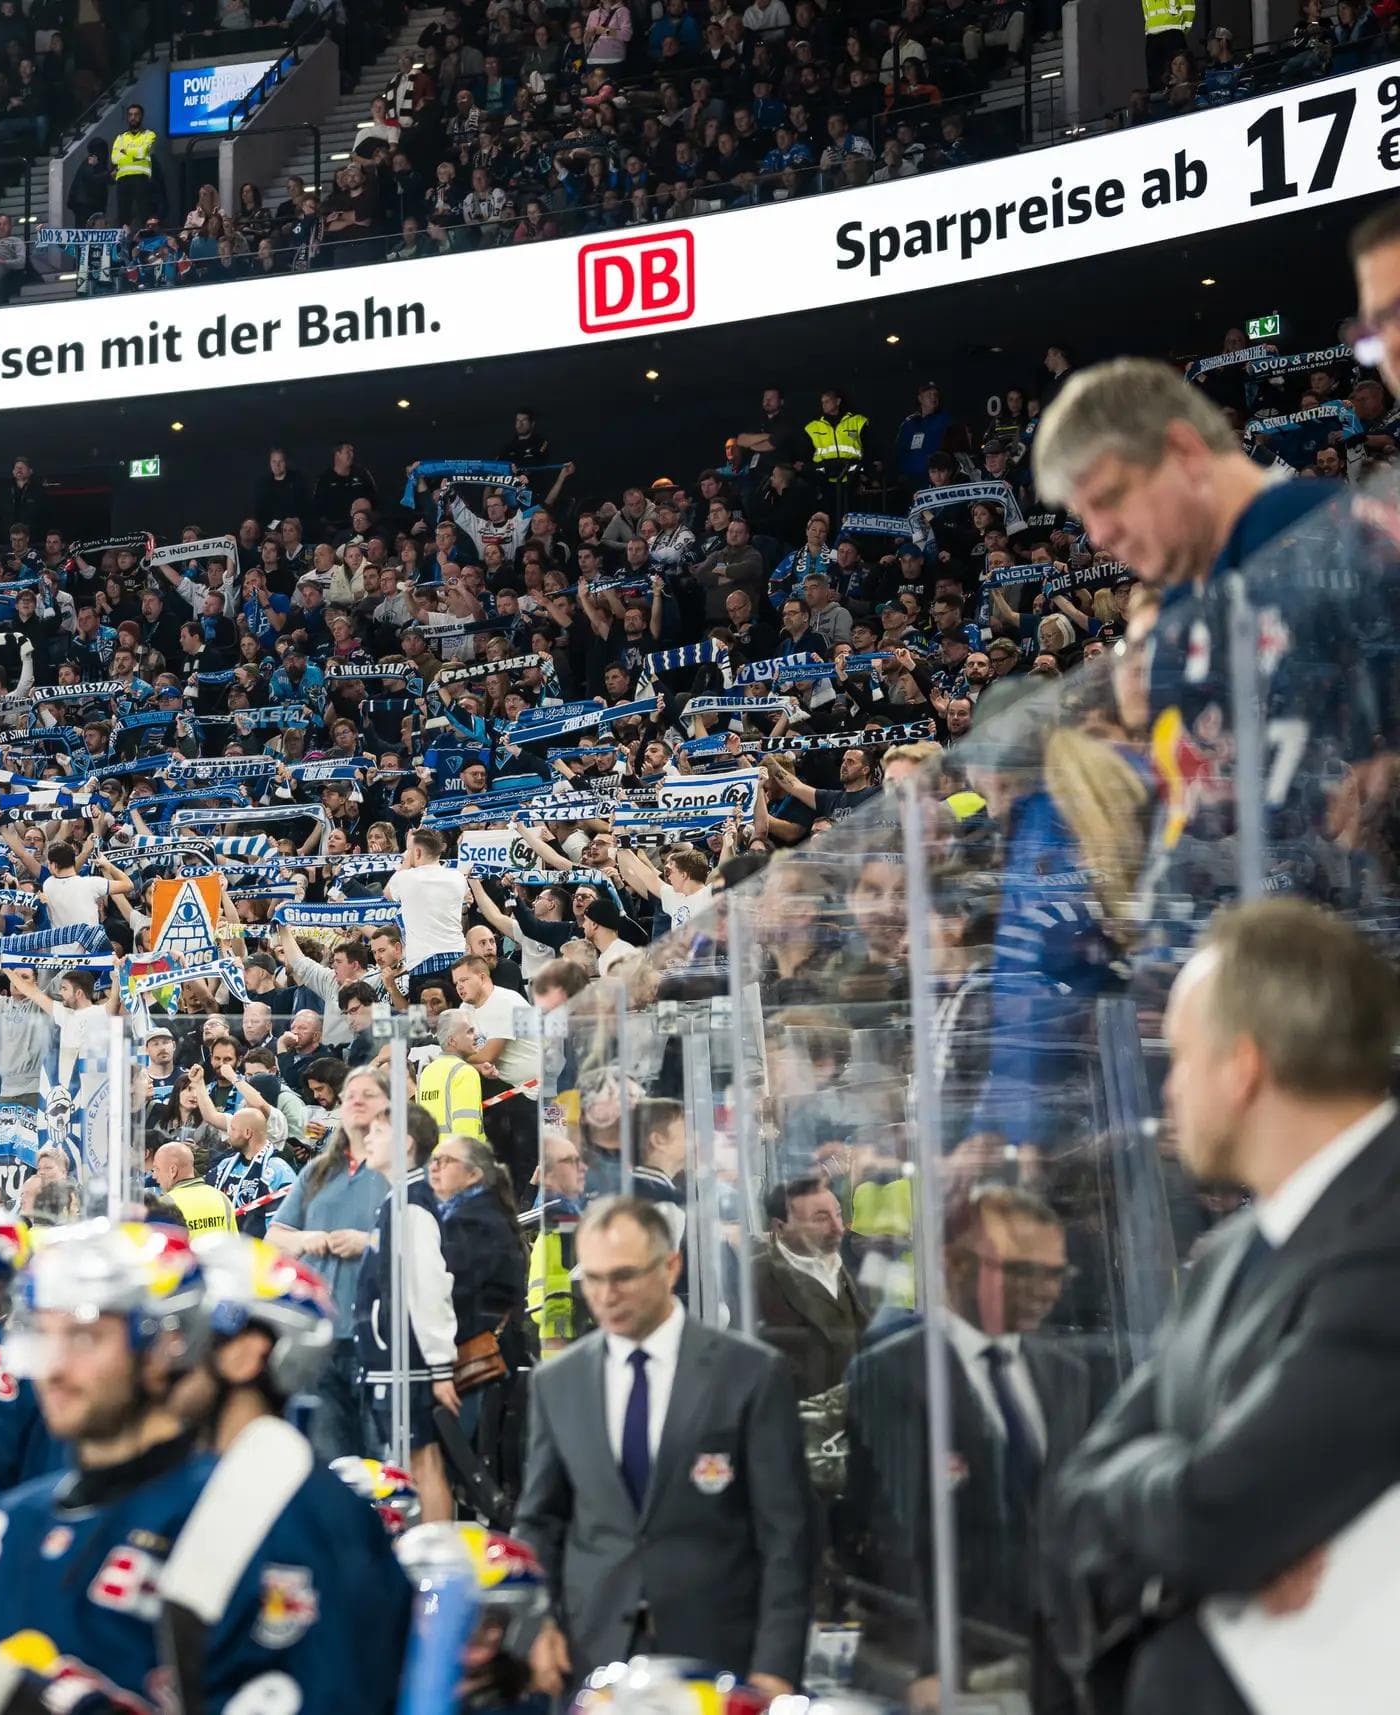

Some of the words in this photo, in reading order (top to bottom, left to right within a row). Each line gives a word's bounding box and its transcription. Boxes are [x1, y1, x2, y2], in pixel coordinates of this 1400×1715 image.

[1378, 76, 1400, 123] 9
[836, 177, 1124, 276] Sparpreise
[1142, 149, 1208, 209] ab
[1247, 89, 1357, 206] 17
[66, 229, 119, 243] PANTHER
[595, 247, 681, 319] DB
[101, 322, 182, 369] mit
[197, 313, 281, 361] der
[298, 295, 442, 349] Bahn.
[1253, 356, 1287, 374] LOUD
[1292, 355, 1302, 366] &
[1289, 406, 1338, 427] PANTHER
[1051, 572, 1072, 591] DIE
[441, 653, 540, 683] PANTHER
[209, 763, 276, 779] JAHRE
[661, 793, 717, 810] Szene
[530, 806, 592, 821] SZENE
[460, 841, 507, 862] Szene
[513, 842, 534, 861] 64
[363, 906, 401, 922] 200
[188, 1215, 225, 1231] SECURITY
